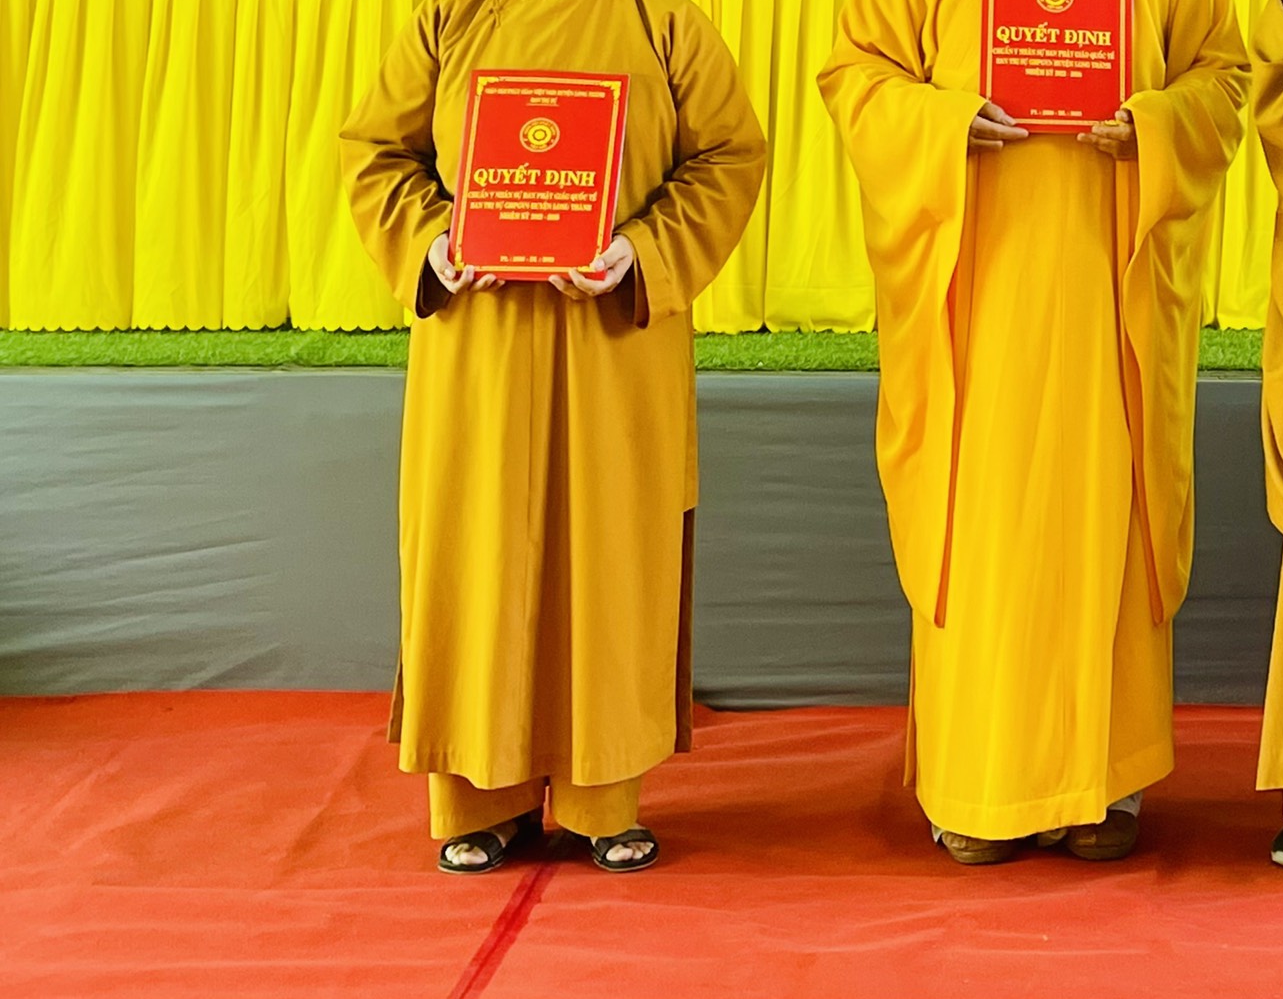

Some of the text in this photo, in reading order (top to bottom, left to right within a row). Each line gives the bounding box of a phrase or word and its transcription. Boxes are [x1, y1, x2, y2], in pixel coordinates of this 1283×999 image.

[996, 22, 1112, 48] QUYẾT ĐỊNH
[473, 163, 595, 189] QUYẾT ĐỊNH
